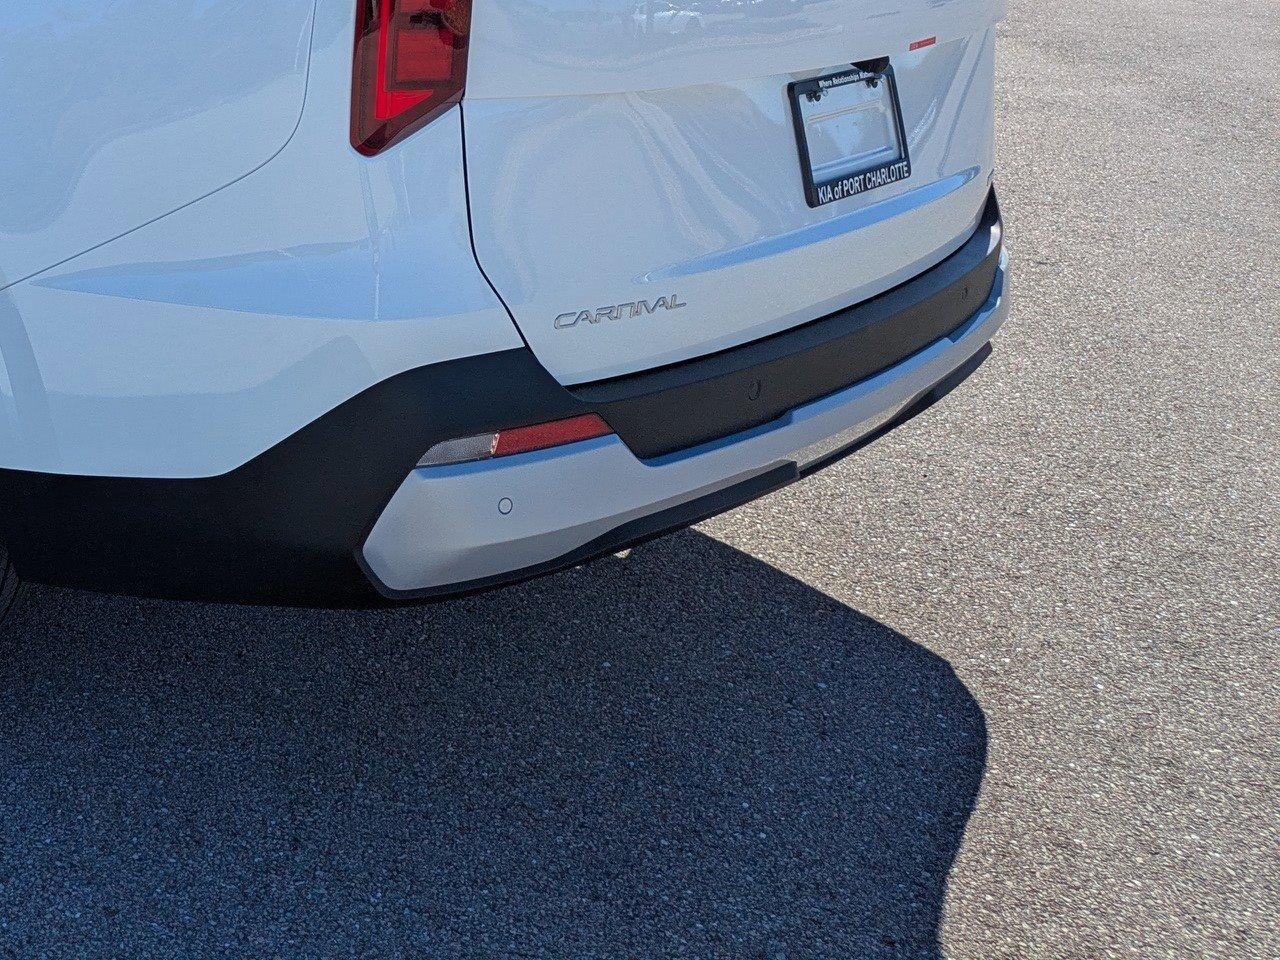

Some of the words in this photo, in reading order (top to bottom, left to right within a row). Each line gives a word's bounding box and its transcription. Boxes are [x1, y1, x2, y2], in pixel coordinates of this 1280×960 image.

[817, 185, 833, 204] KIA
[833, 181, 842, 199] of
[842, 174, 865, 197] PORT
[865, 161, 909, 189] CHARLOTTE
[554, 293, 687, 330] CARNIVAL
